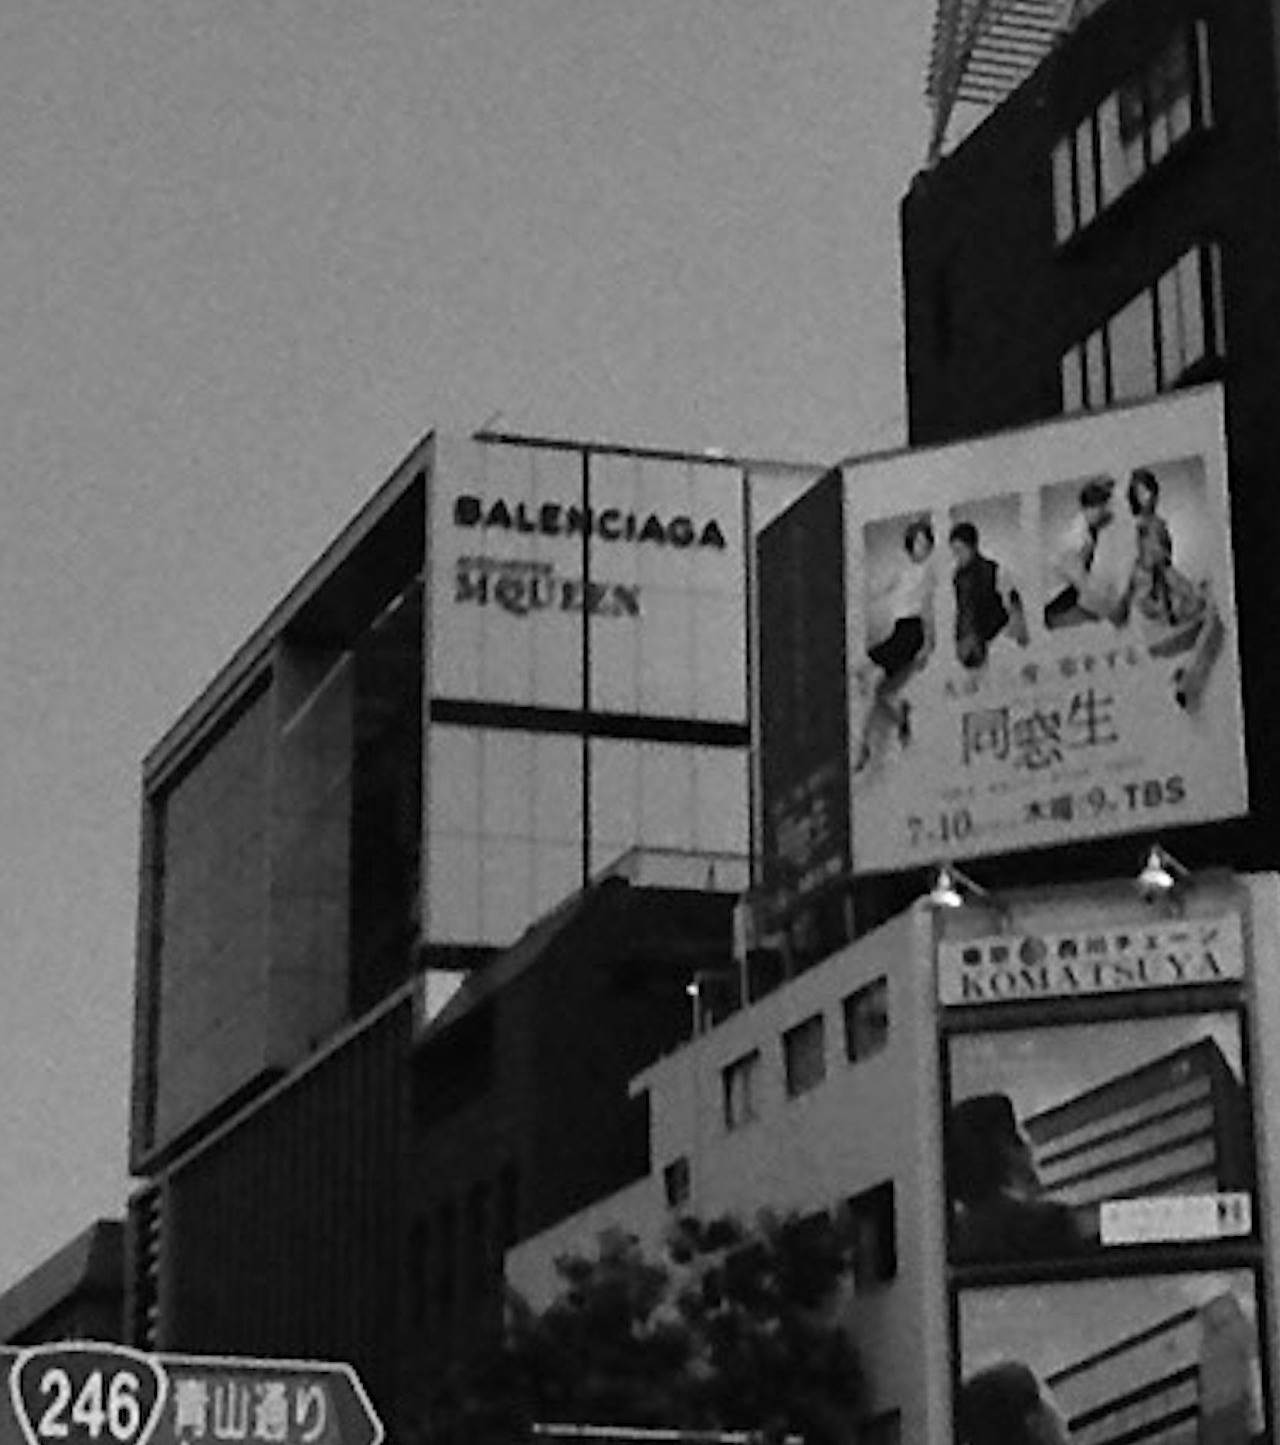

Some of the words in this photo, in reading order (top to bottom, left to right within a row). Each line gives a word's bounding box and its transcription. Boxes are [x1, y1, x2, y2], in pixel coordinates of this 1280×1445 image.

[454, 495, 727, 550] BALENCIAGA
[1123, 774, 1187, 811] TBS
[961, 951, 1221, 998] KOMATSUYA
[37, 1367, 142, 1441] 246
[174, 1378, 326, 1443] 青山通り
